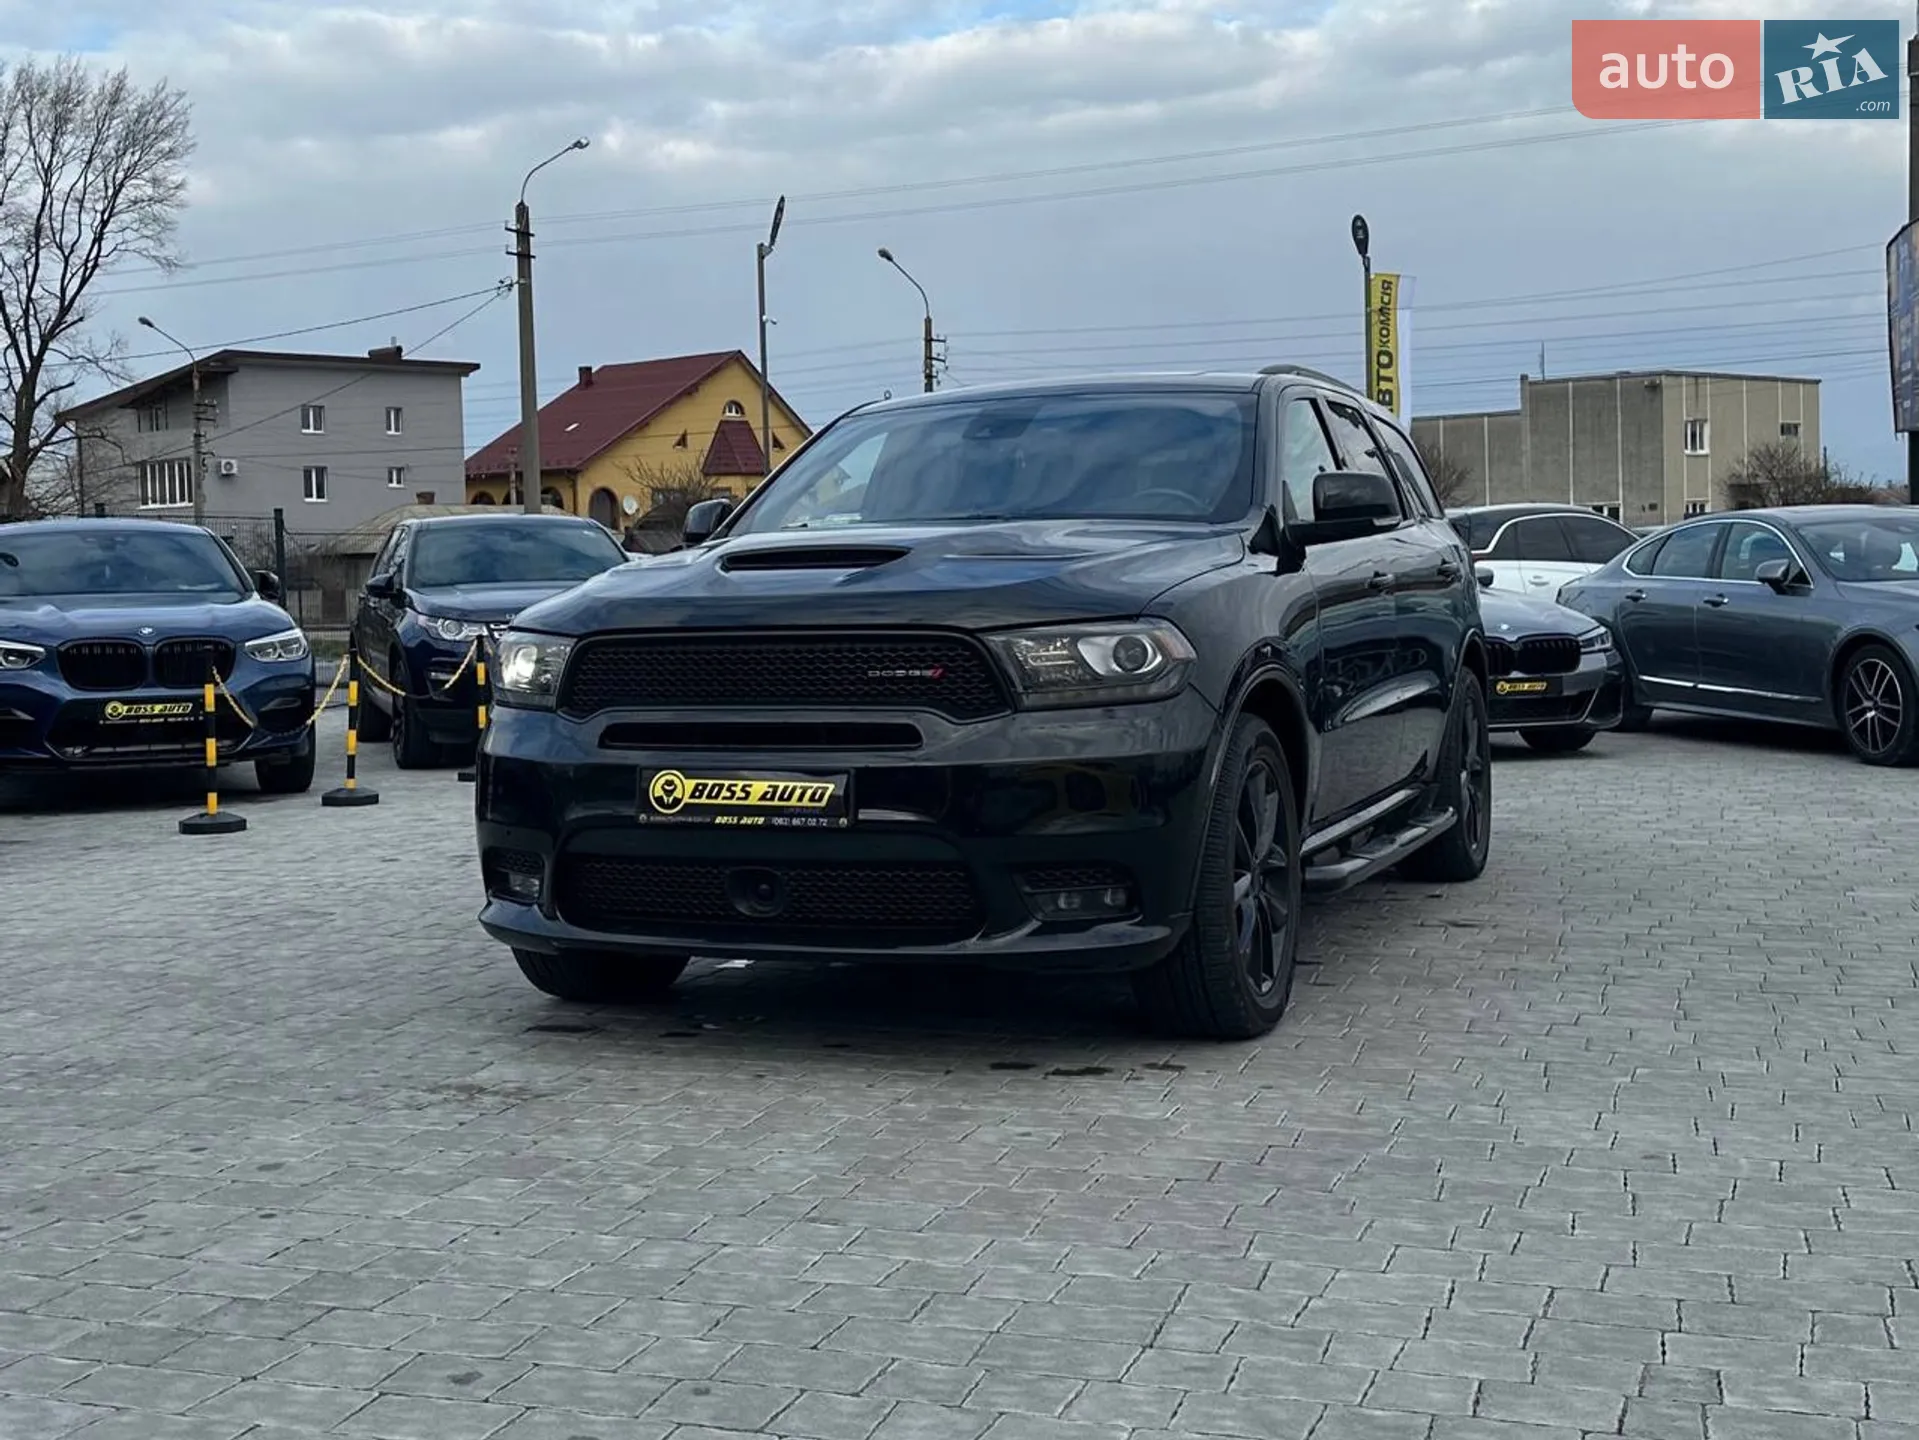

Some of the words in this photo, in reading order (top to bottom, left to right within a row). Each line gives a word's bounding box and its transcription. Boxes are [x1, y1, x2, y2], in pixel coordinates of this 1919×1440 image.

[867, 670, 930, 678] DODGE
[125, 705, 156, 714] BOSS
[157, 704, 189, 713] AUTO
[688, 782, 753, 801] BOSS
[757, 783, 830, 803] AUTO
[714, 816, 738, 825] BOSS
[739, 816, 765, 825] AUTO
